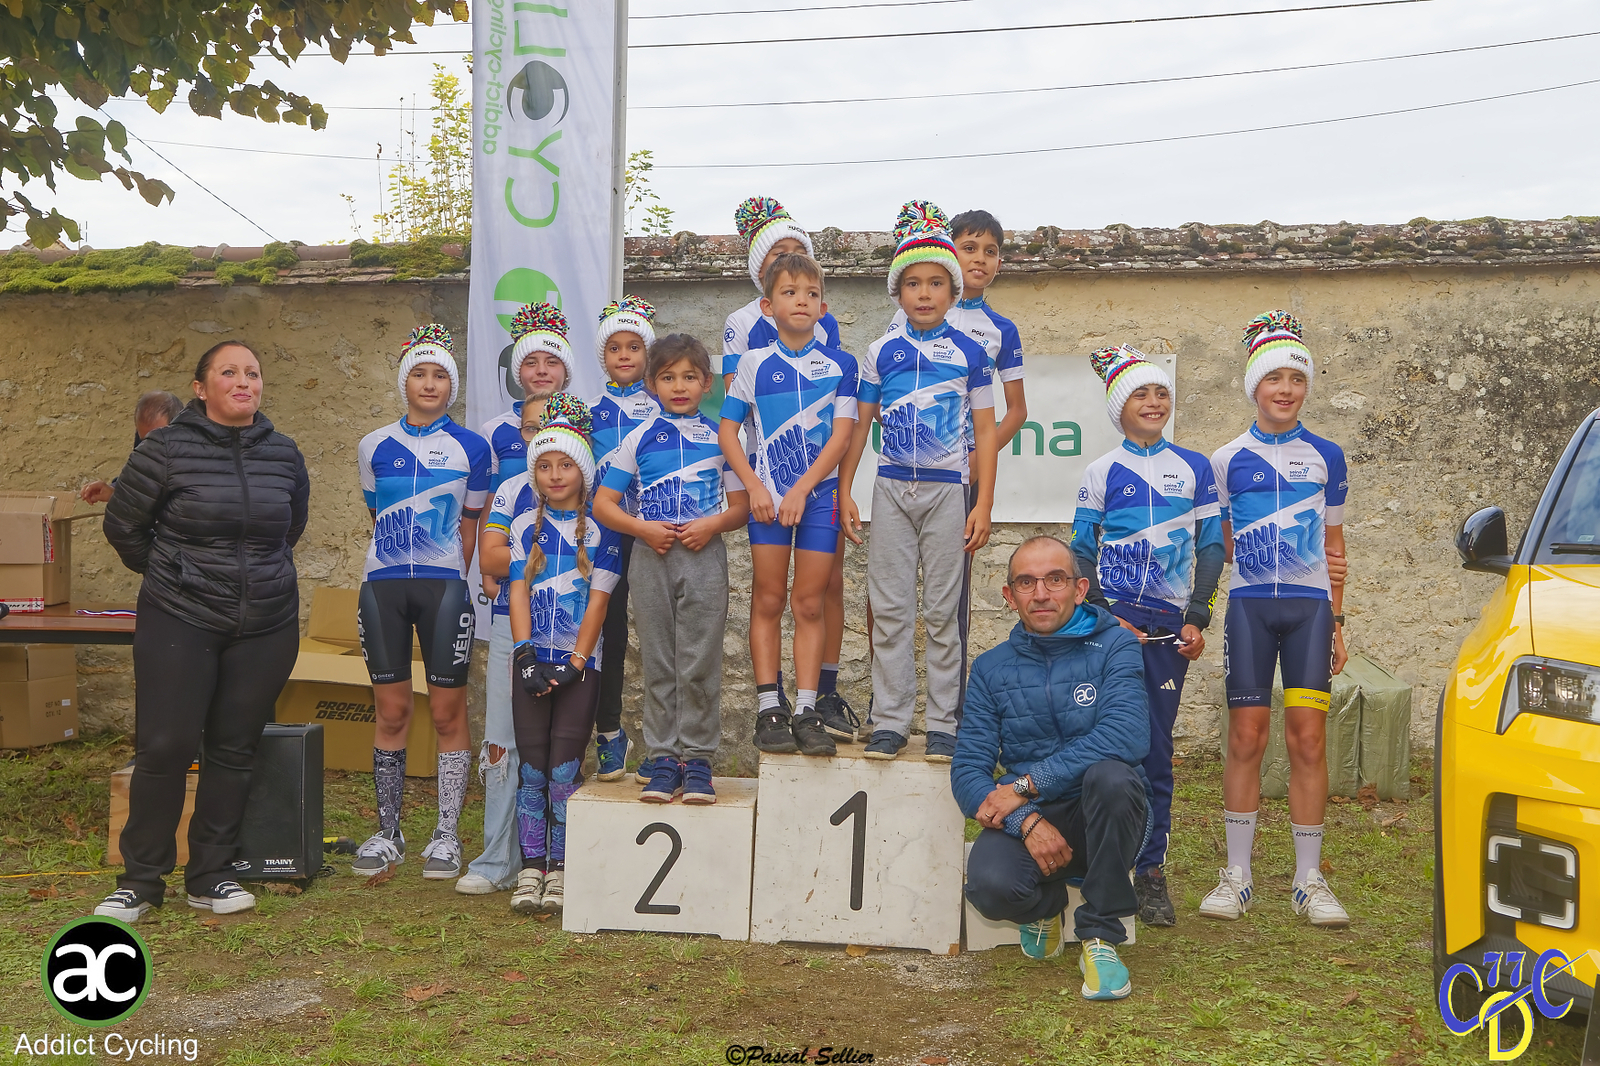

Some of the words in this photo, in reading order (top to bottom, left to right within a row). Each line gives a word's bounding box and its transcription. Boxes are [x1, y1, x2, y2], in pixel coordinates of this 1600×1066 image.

[375, 526, 424, 556] TOUR
[1099, 538, 1150, 564] MINI
[1233, 522, 1277, 556] MINI
[1236, 541, 1290, 574] TOUR
[1100, 561, 1161, 586] TOUR
[453, 612, 471, 666] VÉLO
[315, 700, 376, 713] PROFILE
[1075, 687, 1095, 703] ac
[829, 790, 868, 911] 1
[635, 822, 683, 915] 2
